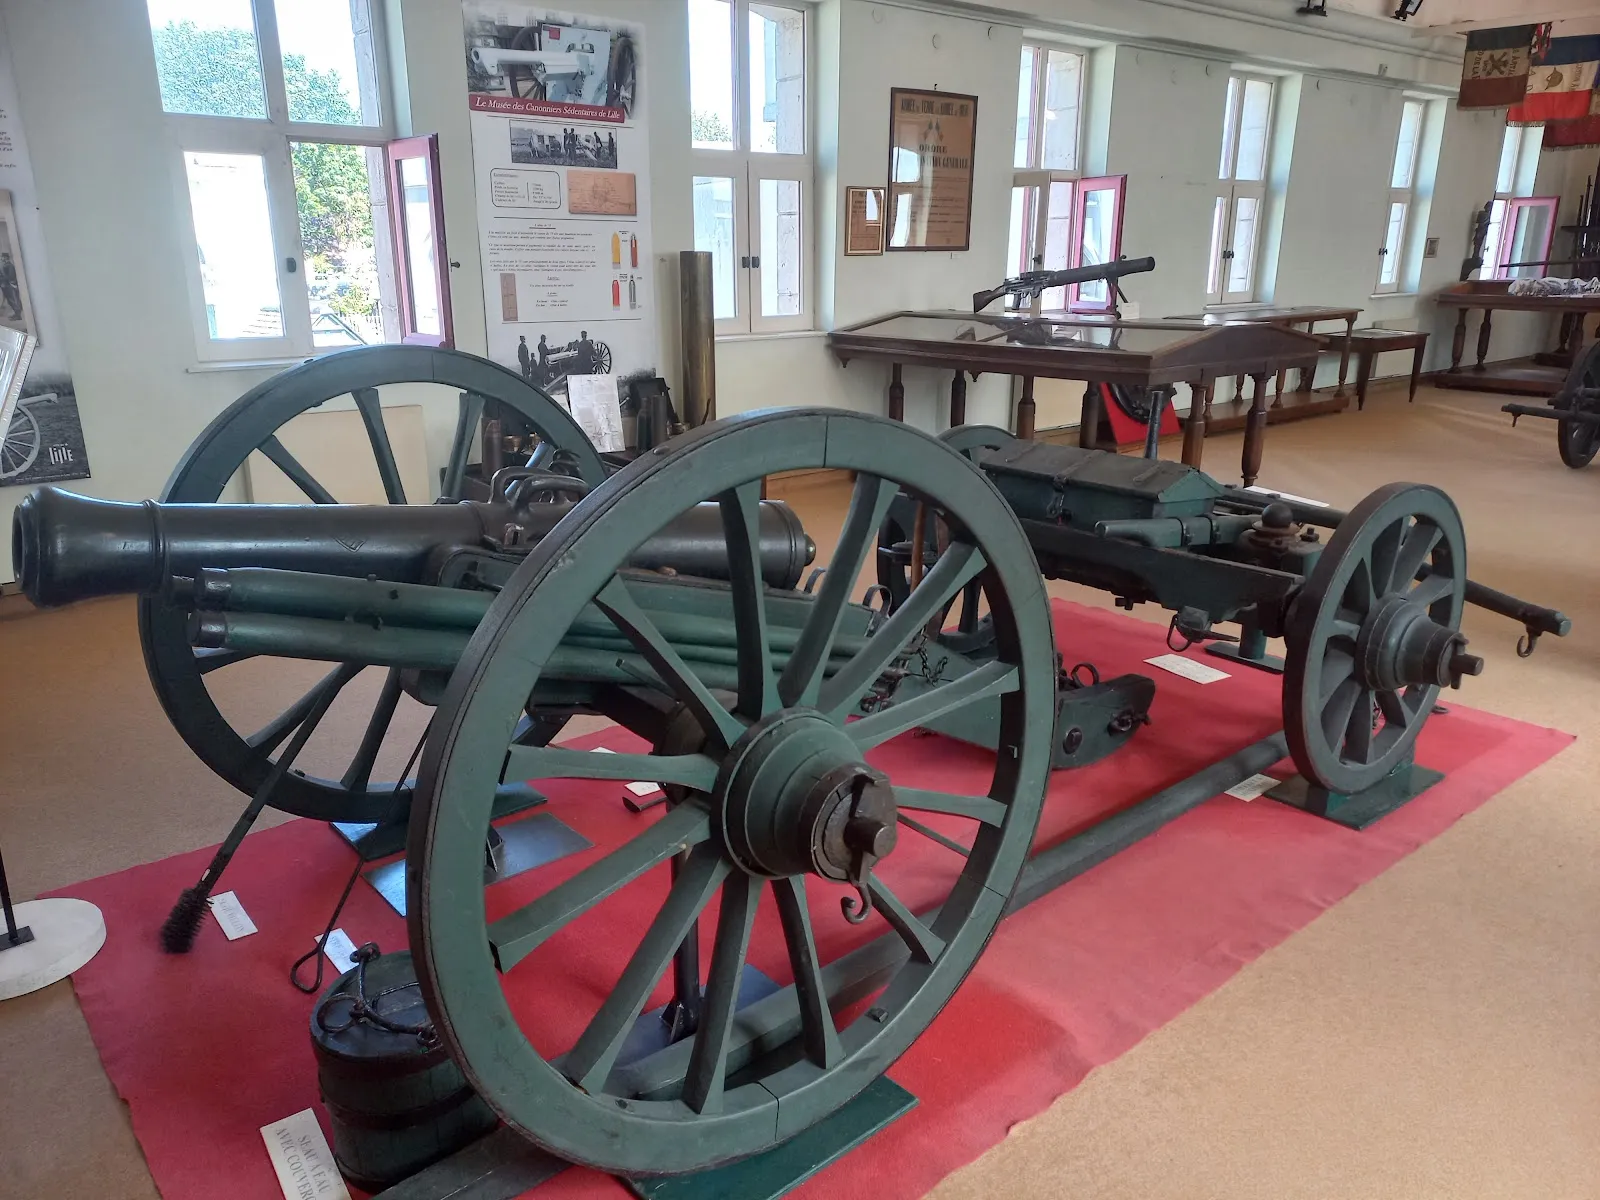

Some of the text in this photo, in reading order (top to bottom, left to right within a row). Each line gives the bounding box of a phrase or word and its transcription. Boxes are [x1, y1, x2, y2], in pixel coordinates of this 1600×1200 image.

[475, 97, 620, 119] Le Musée des Canonniers Sédentaires de Lille
[919, 144, 947, 153] ORDRE
[276, 1128, 297, 1153] AVEC
[298, 1135, 319, 1160] SEAU
[313, 1170, 332, 1193] EAU
